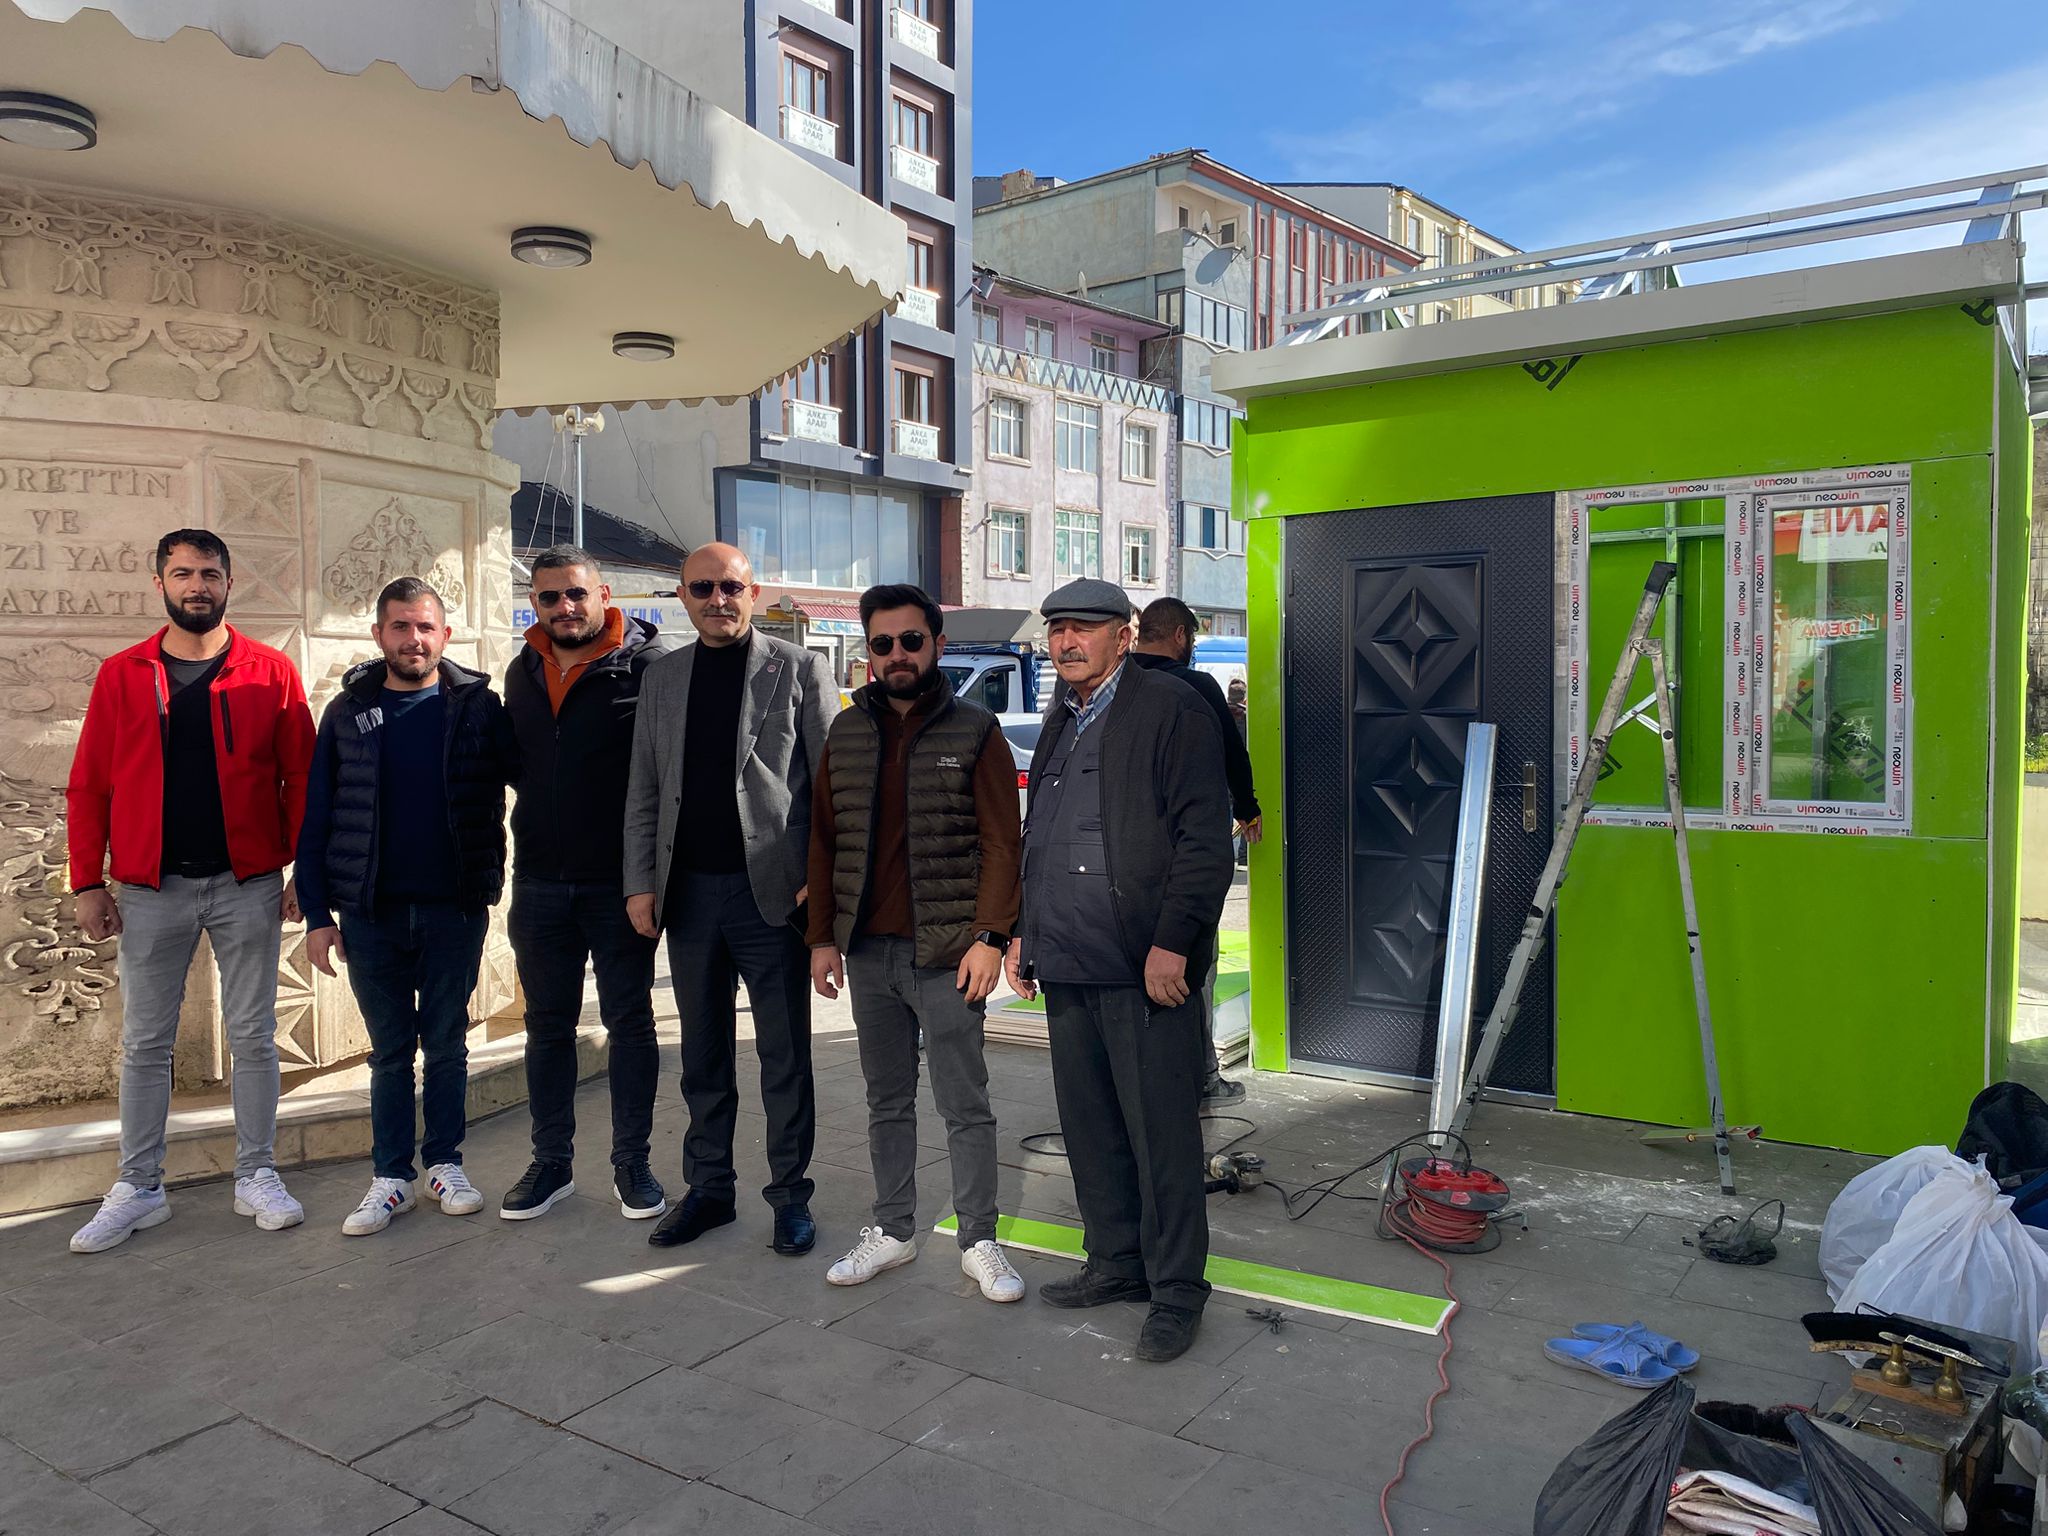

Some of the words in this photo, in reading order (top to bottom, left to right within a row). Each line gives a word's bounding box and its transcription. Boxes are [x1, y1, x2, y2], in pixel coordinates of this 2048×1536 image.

[0, 466, 172, 498] RETTİN
[1668, 484, 1709, 495] neowin
[1754, 477, 1797, 489] neowin
[1846, 469, 1892, 482] neowin
[1815, 491, 1860, 502] neowin
[24, 508, 80, 534] VE
[1571, 508, 1580, 545] neowin
[1739, 501, 1748, 536] neowin
[1896, 497, 1907, 537] neowin
[1734, 541, 1742, 576] neowin
[1755, 555, 1764, 593] neowin
[1571, 584, 1580, 621] neowin
[1739, 581, 1747, 616] neowin
[1894, 581, 1906, 621] neowin
[1733, 621, 1742, 656] neowin
[1754, 635, 1764, 673] neowin
[1571, 660, 1579, 697] neowin
[1738, 661, 1747, 696] neowin
[1893, 664, 1905, 703] neowin
[1733, 701, 1741, 736] neowin
[1754, 714, 1763, 753] neowin
[1570, 735, 1579, 772] neowin
[1737, 741, 1746, 776] neowin
[1892, 747, 1904, 786] neowin
[1732, 781, 1741, 815] neowin
[1797, 804, 1841, 815] neowin
[1731, 822, 1774, 832] neowin
[1822, 826, 1868, 835] neowin
